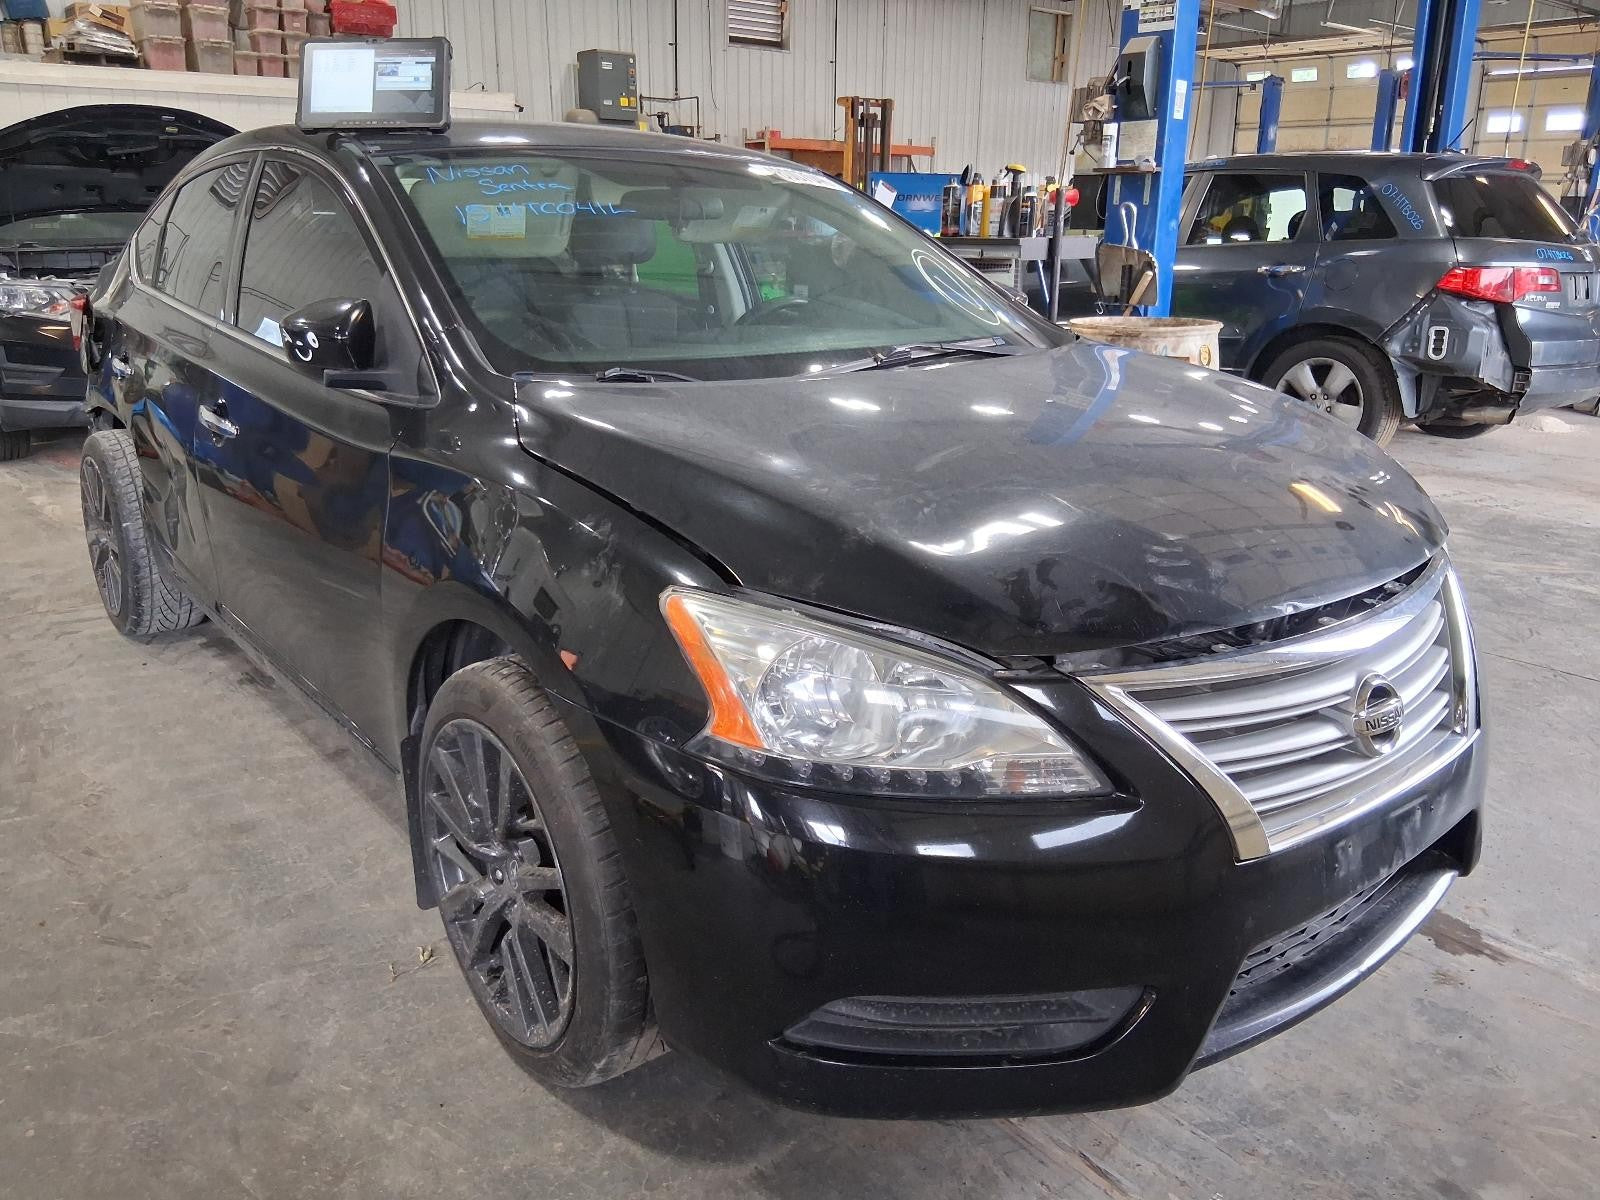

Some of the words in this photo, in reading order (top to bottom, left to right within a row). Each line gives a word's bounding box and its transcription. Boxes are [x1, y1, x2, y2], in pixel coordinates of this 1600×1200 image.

[426, 164, 530, 185] Nissan
[478, 178, 576, 195] Sentra
[896, 193, 943, 202] ORNWE
[1365, 703, 1404, 732] NISSAN
